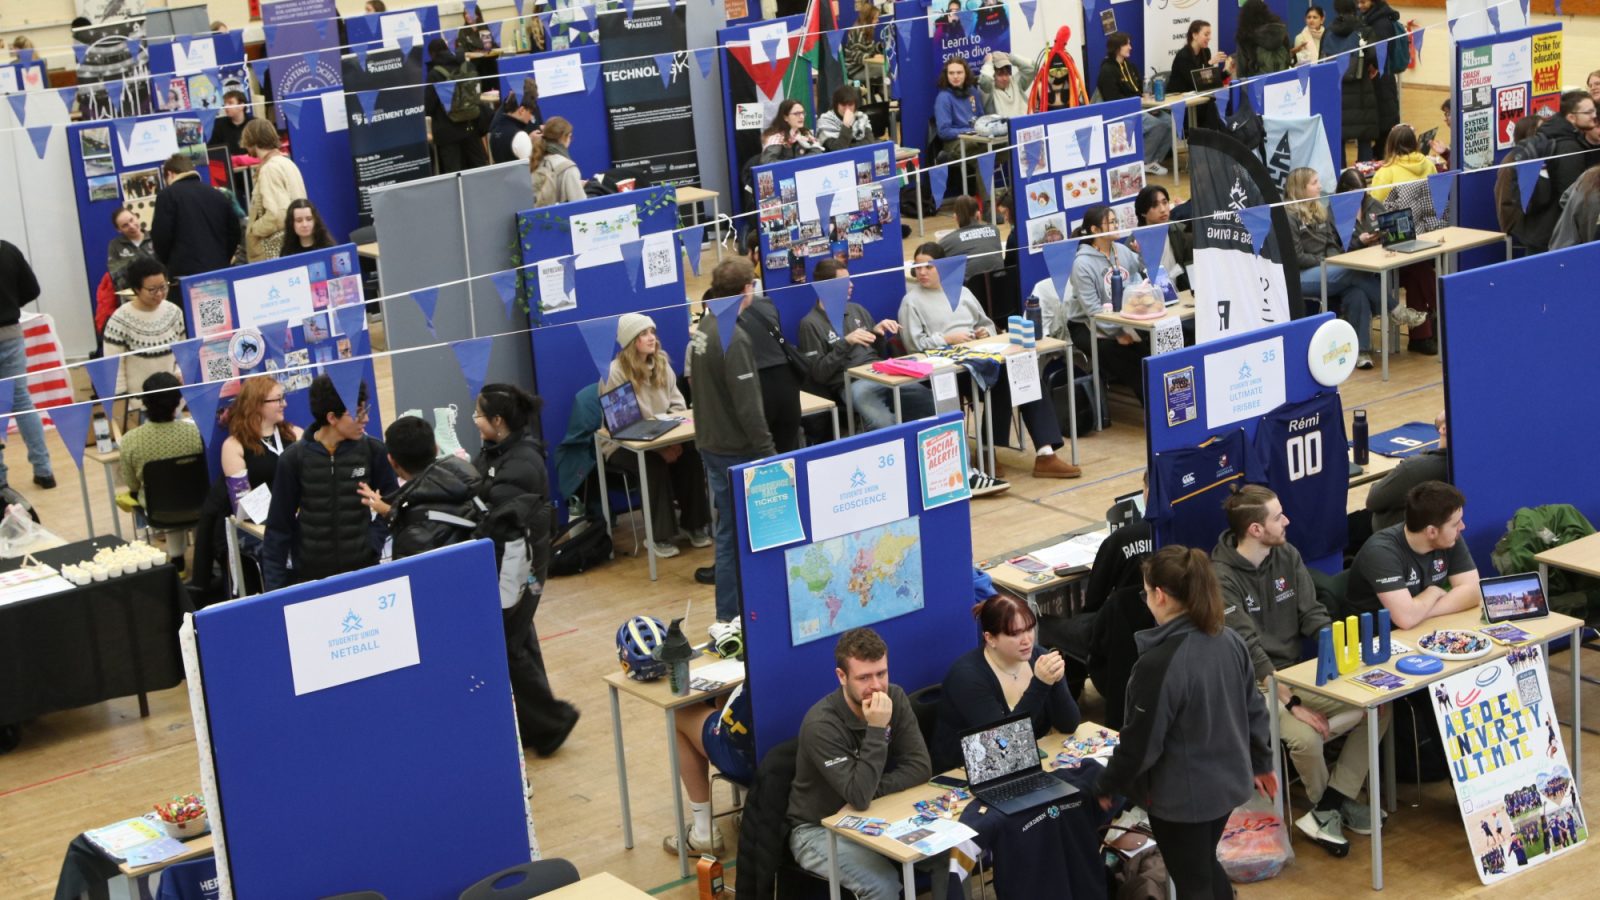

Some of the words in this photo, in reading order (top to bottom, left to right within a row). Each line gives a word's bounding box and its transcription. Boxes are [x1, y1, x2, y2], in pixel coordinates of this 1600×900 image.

[631, 20, 662, 29] ABERDEEN
[942, 36, 969, 50] Learn
[970, 34, 981, 45] to
[1534, 43, 1551, 53] Strike
[1552, 40, 1561, 49] for
[971, 45, 992, 58] dive
[1533, 52, 1561, 64] education
[373, 63, 403, 73] ABERDEEN
[1463, 70, 1481, 79] SMASH
[1463, 75, 1492, 88] CAPITALISM
[1501, 88, 1524, 101] JOIN
[404, 105, 425, 117] GROUP
[1501, 98, 1524, 112] THE
[741, 119, 762, 127] Divest
[1464, 117, 1489, 128] SYSTEM
[1464, 124, 1490, 135] CHANGE
[1464, 133, 1477, 141] NOT
[1464, 137, 1490, 149] CLIMATE
[1464, 145, 1489, 156] CHANGE
[288, 277, 301, 287] 54
[1262, 349, 1276, 363] 35
[1229, 387, 1263, 402] ULTIMATE
[1232, 399, 1261, 413] FRISBEE
[1288, 412, 1320, 433] Rémi
[926, 437, 954, 460] SOCIAL
[878, 453, 895, 469] 36
[928, 445, 958, 470] ALERT!!
[1286, 430, 1323, 482] 00
[754, 493, 789, 507] TICKETS
[832, 491, 888, 514] GEOSCIENCE
[377, 591, 397, 610] 37
[360, 627, 380, 639] UNION
[330, 639, 381, 660] NETBALL
[1444, 688, 1521, 739] ABERDEEN
[1447, 702, 1541, 761] UNIVERSITY
[1452, 733, 1534, 783] ULTIMATE
